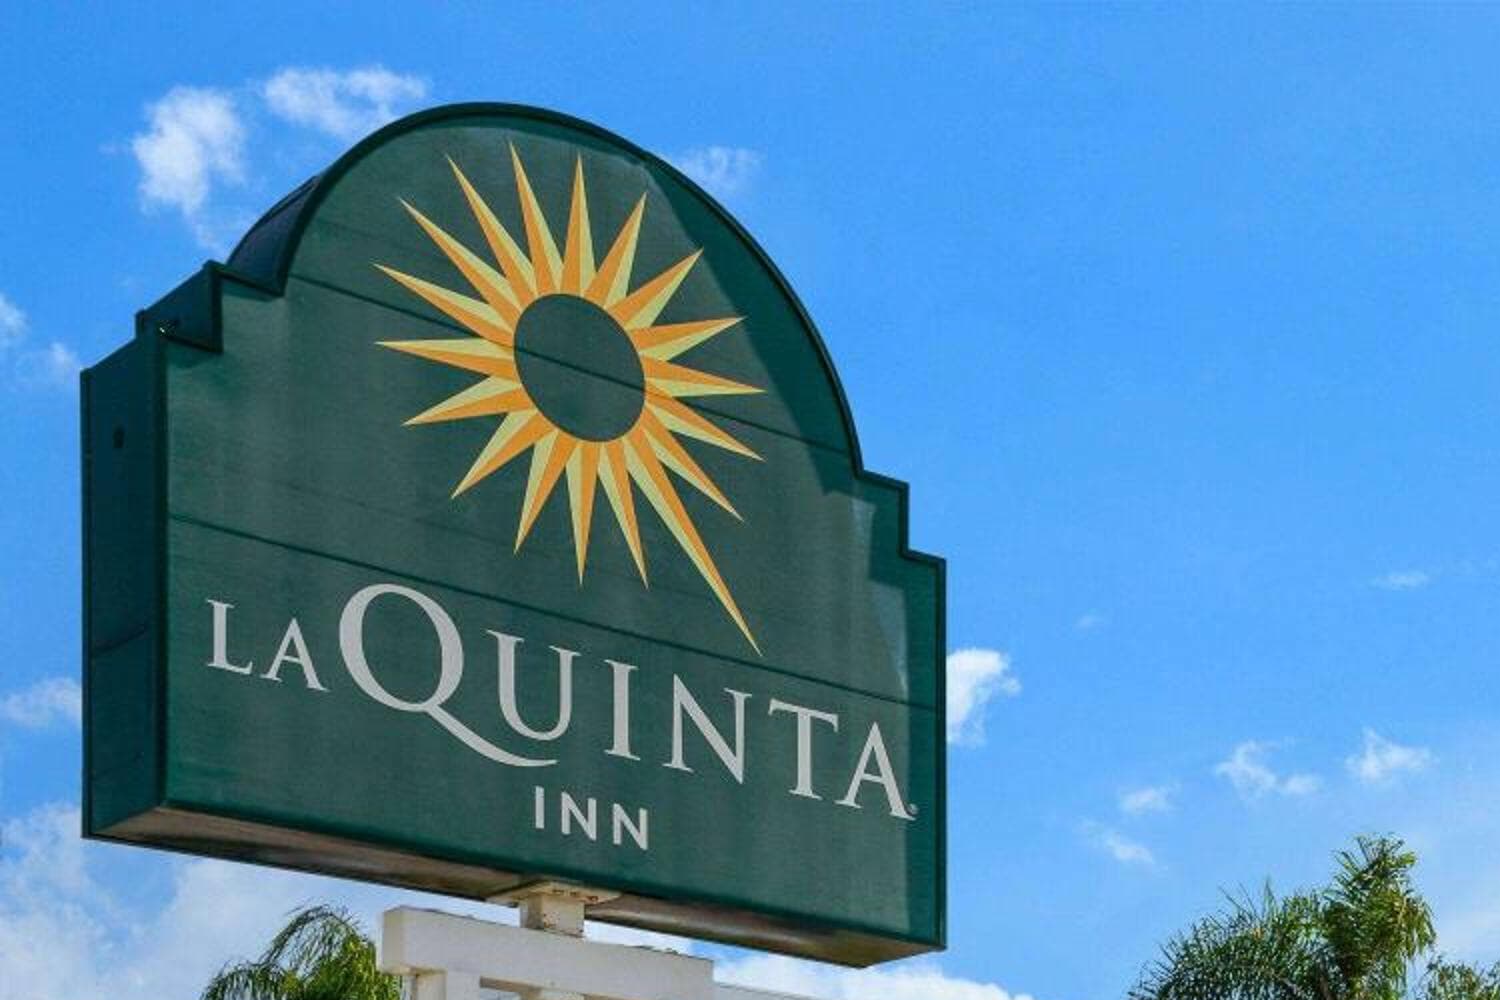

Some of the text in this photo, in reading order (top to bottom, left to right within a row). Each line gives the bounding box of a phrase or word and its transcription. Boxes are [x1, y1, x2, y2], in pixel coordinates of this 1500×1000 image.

[207, 583, 916, 821] LA QUINTA
[535, 785, 649, 851] INN
